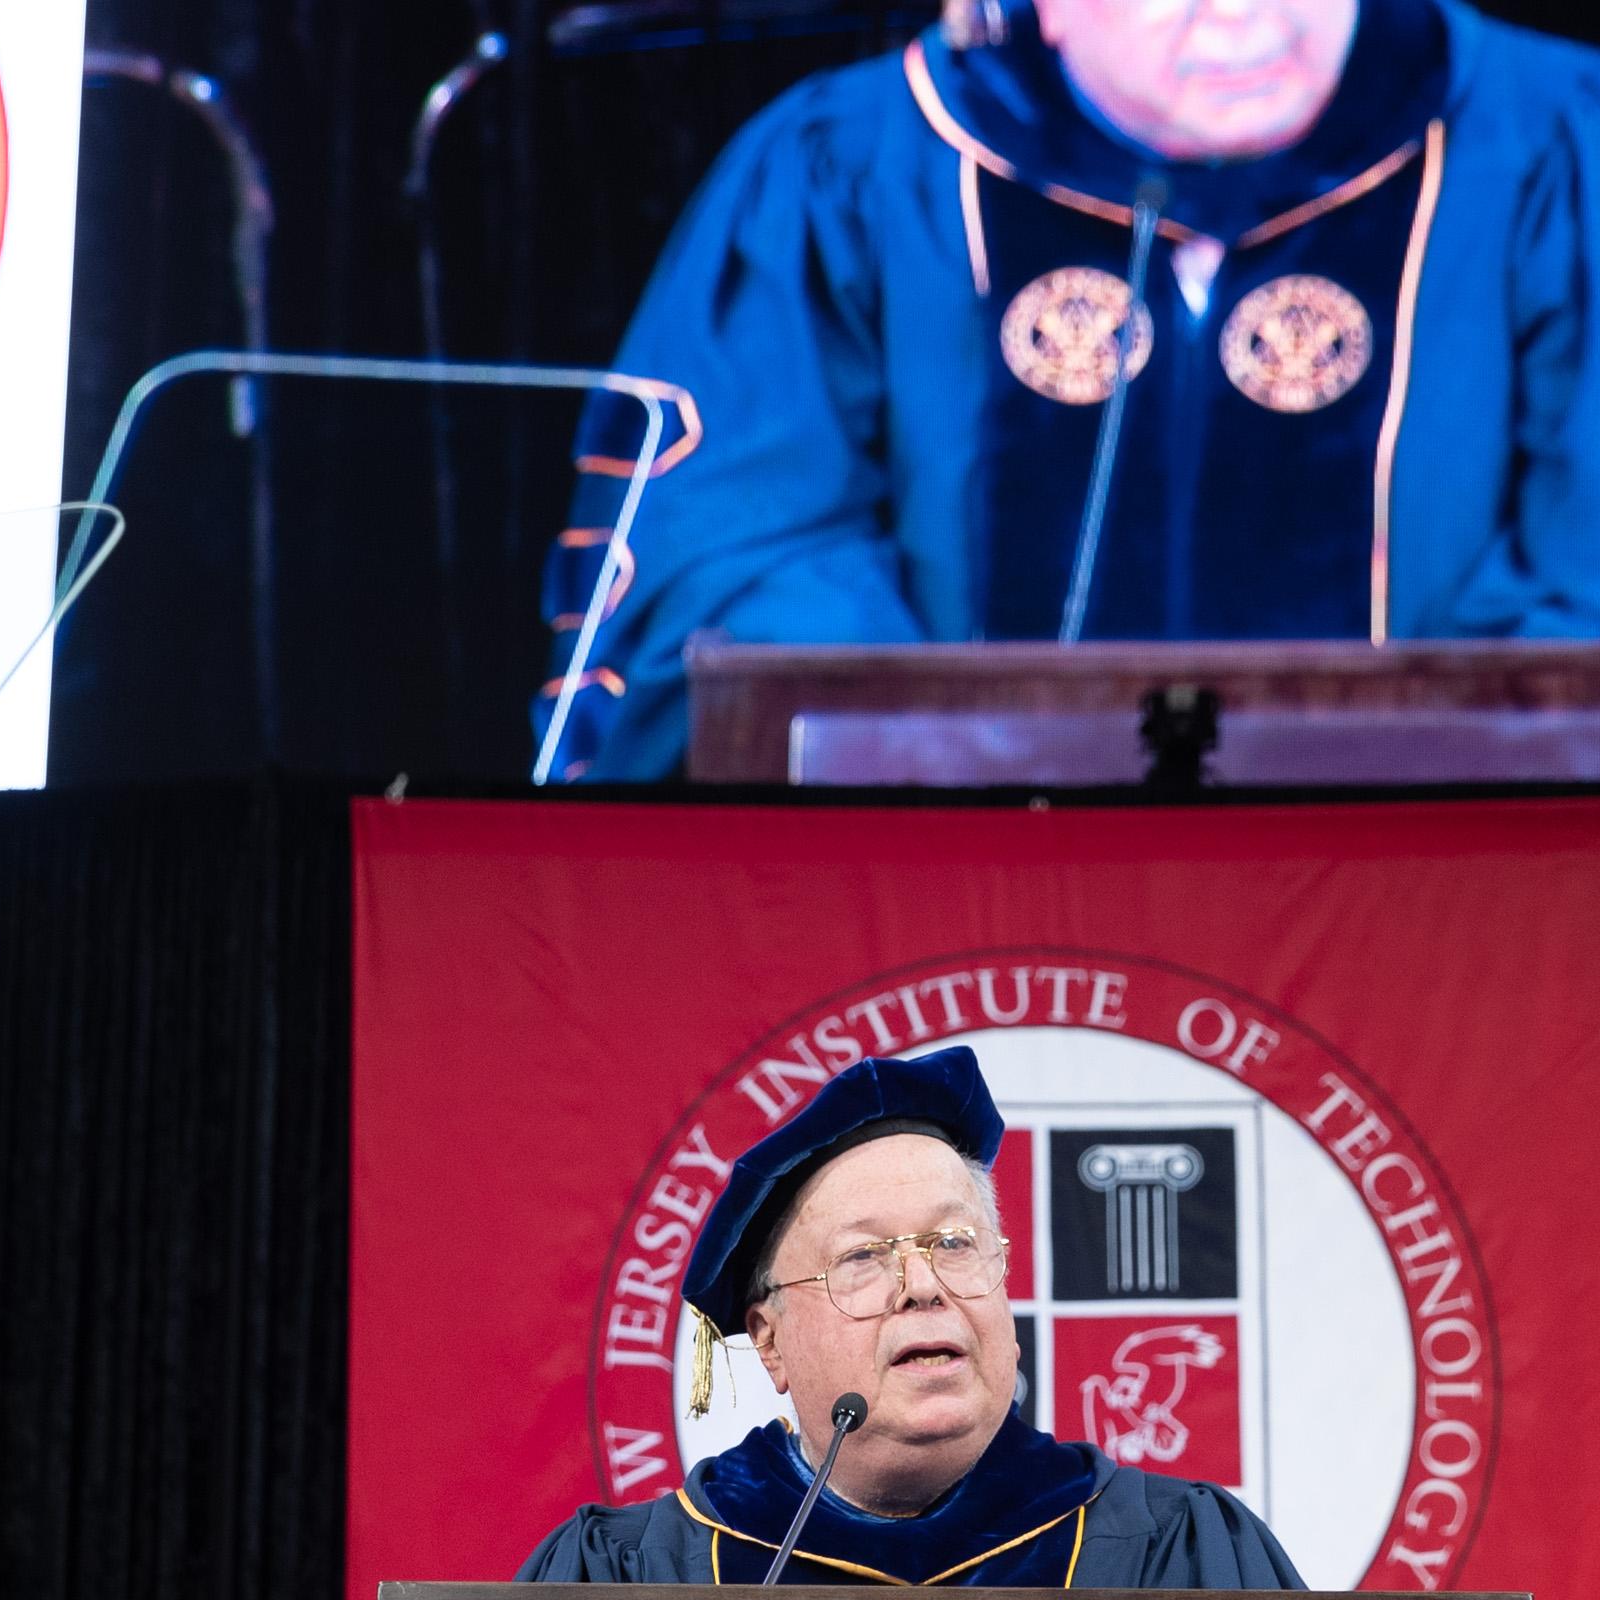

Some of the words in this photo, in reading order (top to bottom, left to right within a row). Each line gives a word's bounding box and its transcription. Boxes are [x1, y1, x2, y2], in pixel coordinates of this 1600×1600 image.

[603, 1123, 734, 1376] JERSEY
[735, 967, 1129, 1125] INSTITUTE
[1176, 998, 1281, 1078] OF
[1302, 1071, 1483, 1590] TECHNOLOGY
